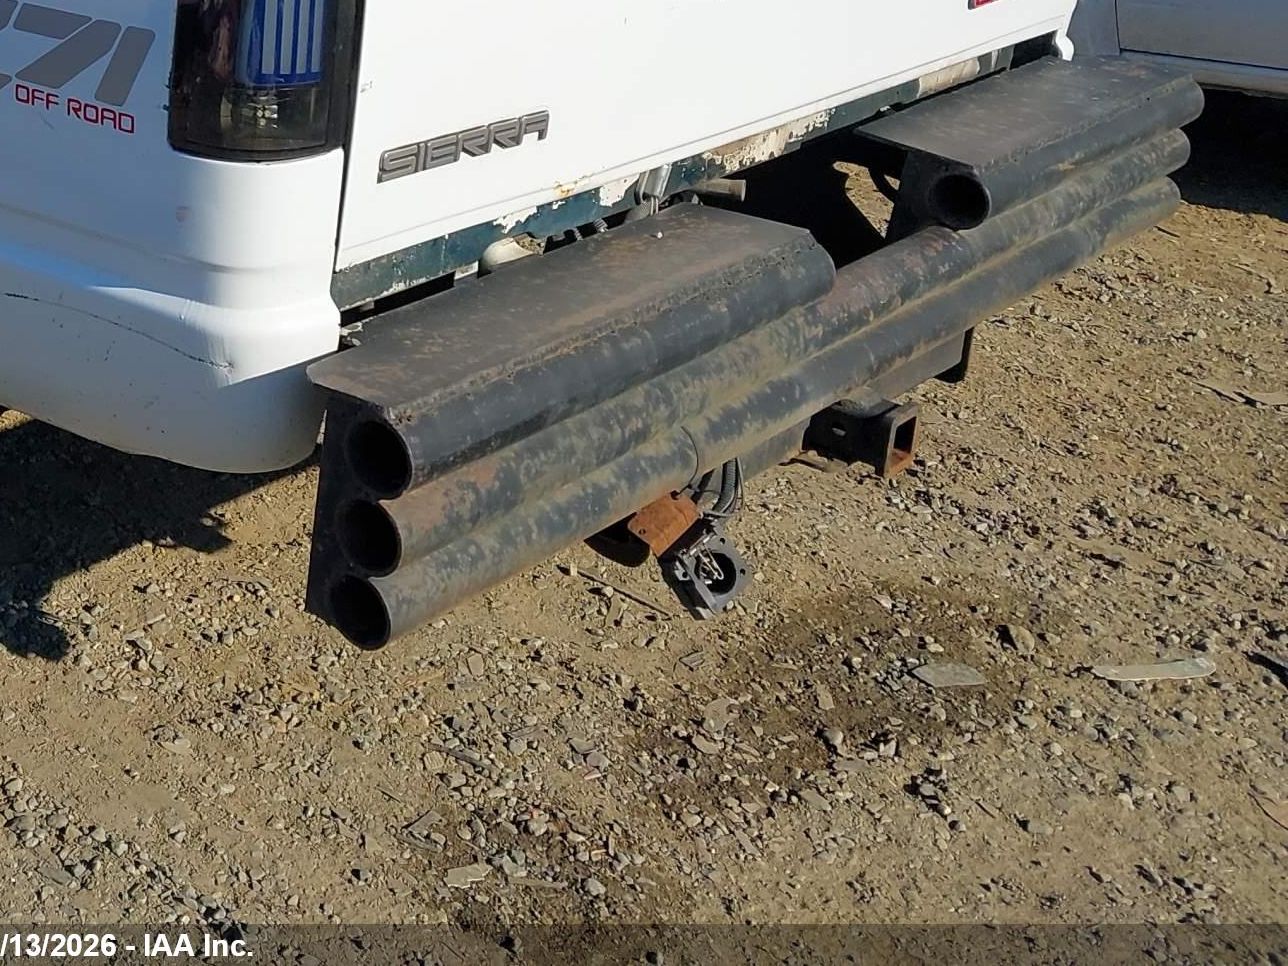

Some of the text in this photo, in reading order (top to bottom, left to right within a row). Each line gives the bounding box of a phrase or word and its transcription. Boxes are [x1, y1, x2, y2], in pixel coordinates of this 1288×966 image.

[15, 84, 135, 135] OFF ROAD
[377, 109, 550, 184] SIERRA
